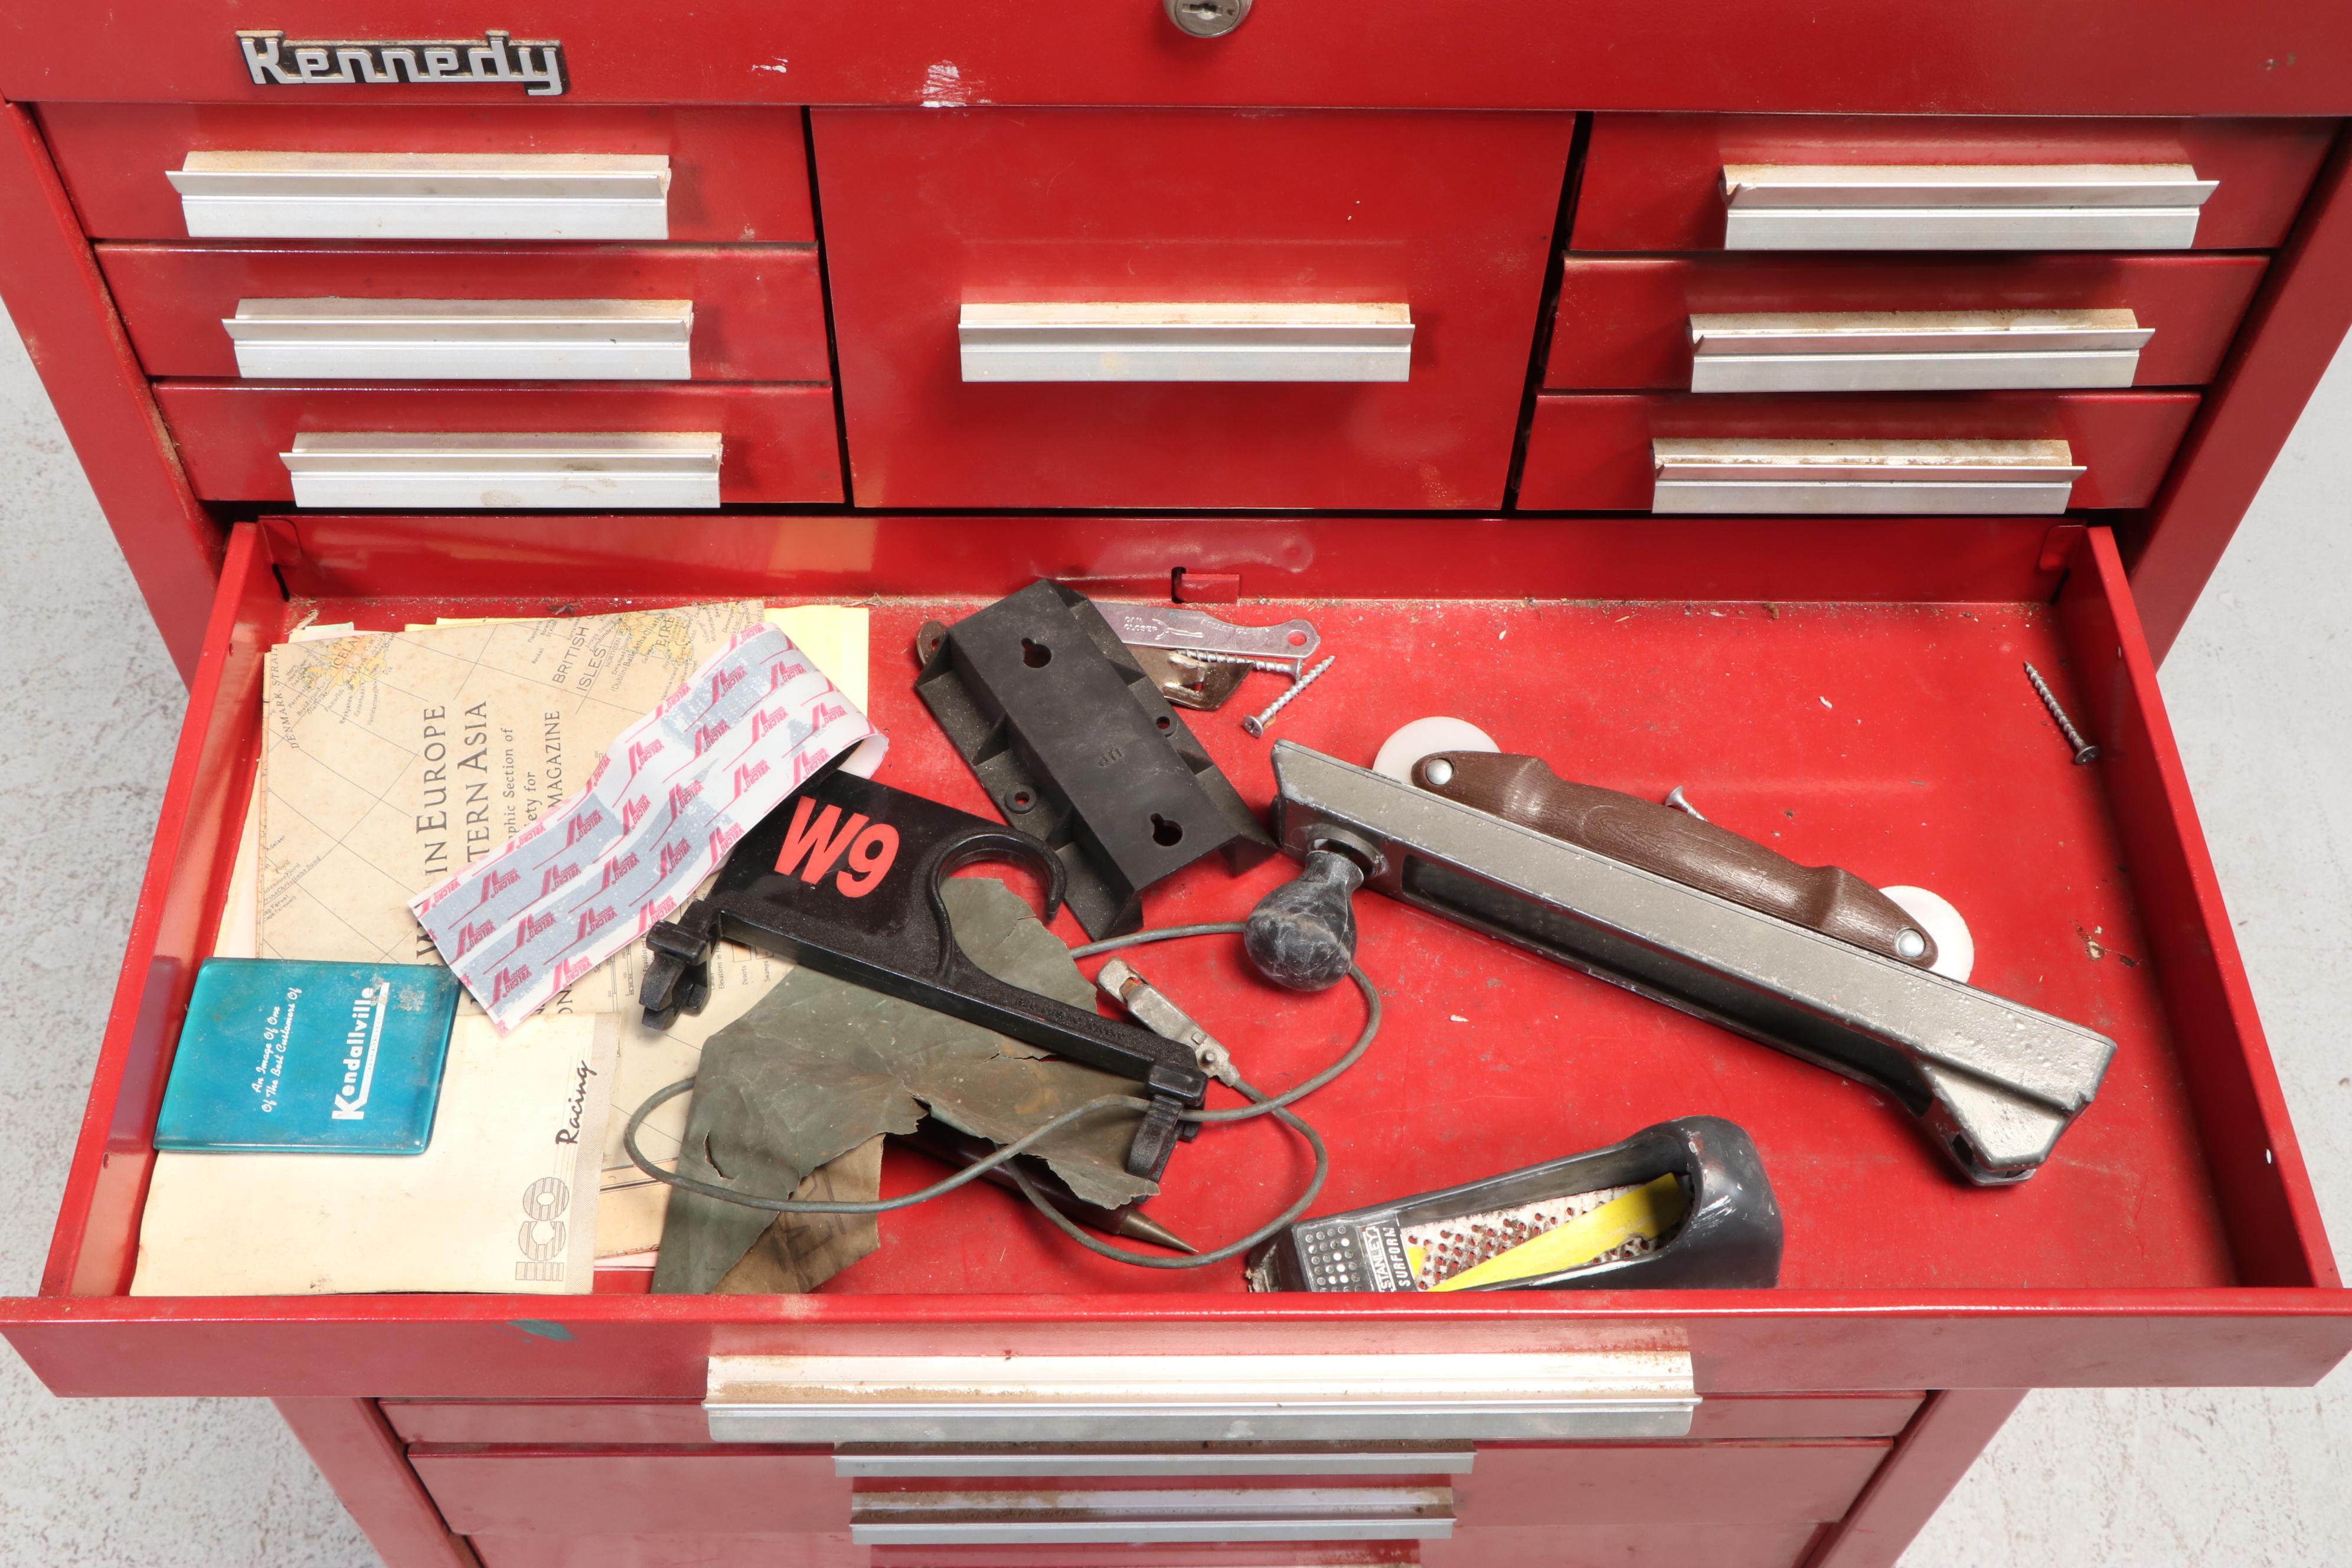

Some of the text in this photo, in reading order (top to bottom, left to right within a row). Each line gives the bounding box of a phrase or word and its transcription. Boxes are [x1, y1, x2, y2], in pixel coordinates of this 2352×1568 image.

[237, 34, 565, 96] Kennedy
[655, 616, 675, 647] EIRE
[741, 625, 766, 642] VELCRO
[552, 626, 590, 684] BRITISH
[576, 648, 606, 692] ISLES
[723, 668, 747, 693] VELCRO
[782, 665, 807, 683] VELCRO
[667, 684, 691, 710] VELCRO
[274, 691, 299, 750] DENMARK
[763, 709, 789, 733] VELCRO
[824, 709, 848, 724] VELCRO
[500, 727, 514, 741] of
[705, 722, 731, 749] VELCRO
[544, 710, 563, 809] MAGAZINE
[639, 741, 665, 767] VELCRO
[805, 752, 831, 776] VELCRO
[502, 747, 515, 798] Section
[594, 754, 612, 782] VELCRO
[746, 763, 771, 788] VELCRO
[416, 705, 448, 875] IN EUROPE
[457, 700, 491, 863] TERN ASIA
[527, 771, 536, 792] for
[679, 784, 704, 809] VELCRO
[632, 799, 651, 825] VELCRO
[520, 824, 546, 845] VELCRO
[579, 815, 603, 839] VELCRO
[720, 827, 745, 853] VELCRO
[671, 842, 691, 870] VELCRO
[774, 795, 900, 898] W9
[554, 865, 582, 888] VELCRO
[615, 856, 640, 880] VELCRO
[435, 880, 460, 904] VELCRO
[494, 872, 521, 894] VELCRO
[590, 910, 618, 932] VELCRO
[651, 900, 677, 923] VELCRO
[470, 925, 496, 948] VELCRO
[529, 916, 557, 939] VELCRO
[505, 969, 531, 993] VELCRO
[566, 960, 593, 984] VELCRO
[717, 961, 726, 990] Elevations
[251, 1006, 280, 1093] An Image Of One
[262, 987, 302, 1112] Of The Best Customers Of
[331, 986, 376, 1120] Kendallville
[556, 1060, 597, 1145] Racing
[1366, 1230, 1392, 1290] STANLEY
[1382, 1227, 1411, 1287] SURFORM
